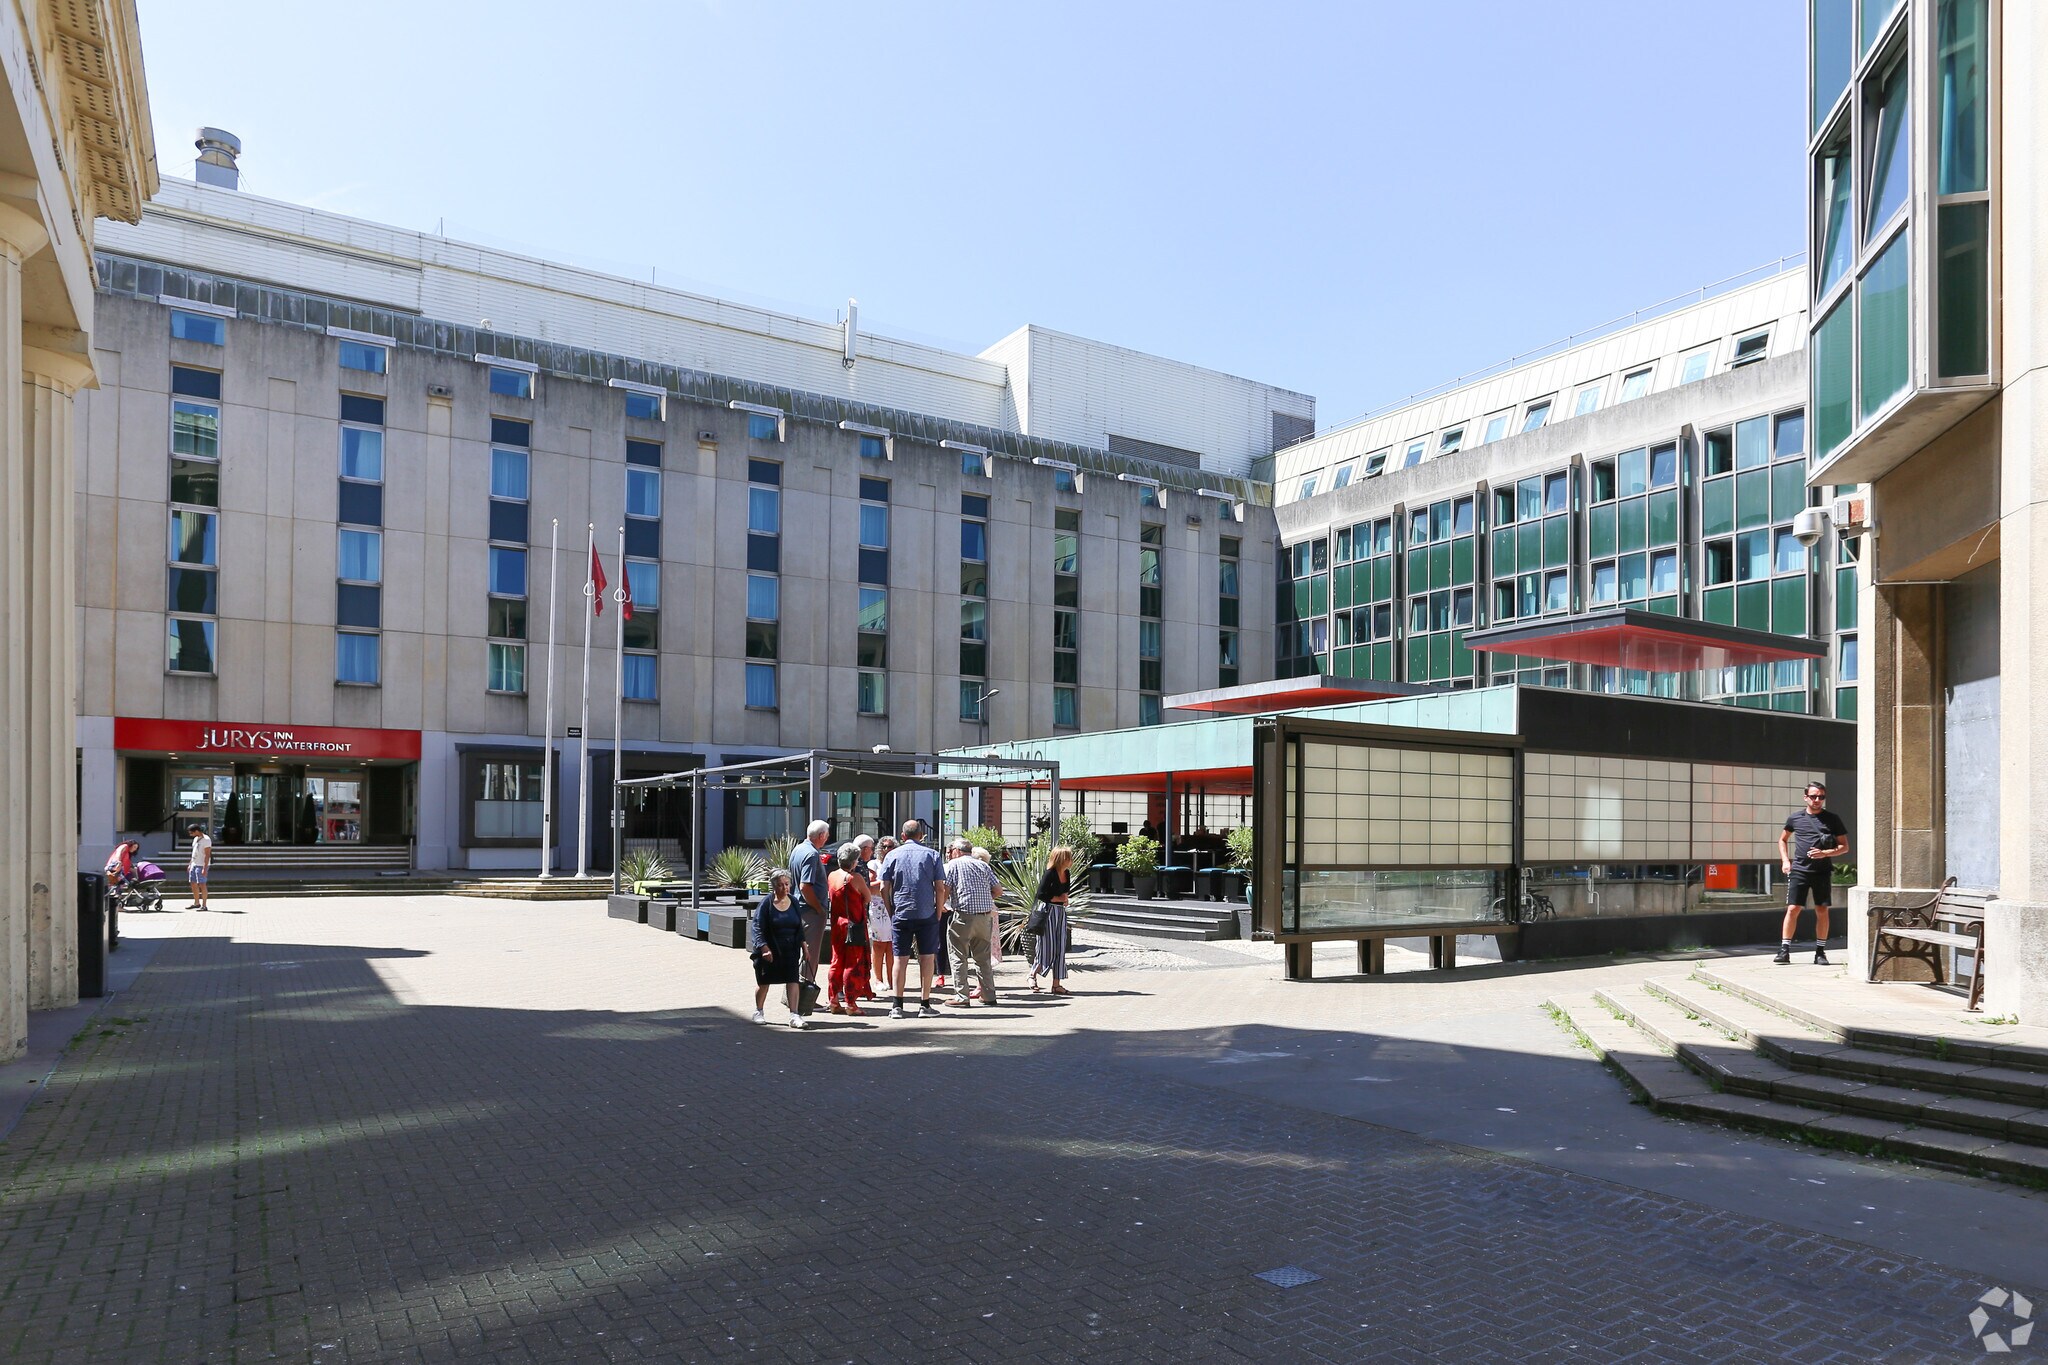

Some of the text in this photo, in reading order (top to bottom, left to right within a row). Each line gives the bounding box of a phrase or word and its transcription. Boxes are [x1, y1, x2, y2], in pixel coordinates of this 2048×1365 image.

[196, 727, 293, 749] JURYS INN
[274, 741, 352, 752] WATERFRONT
